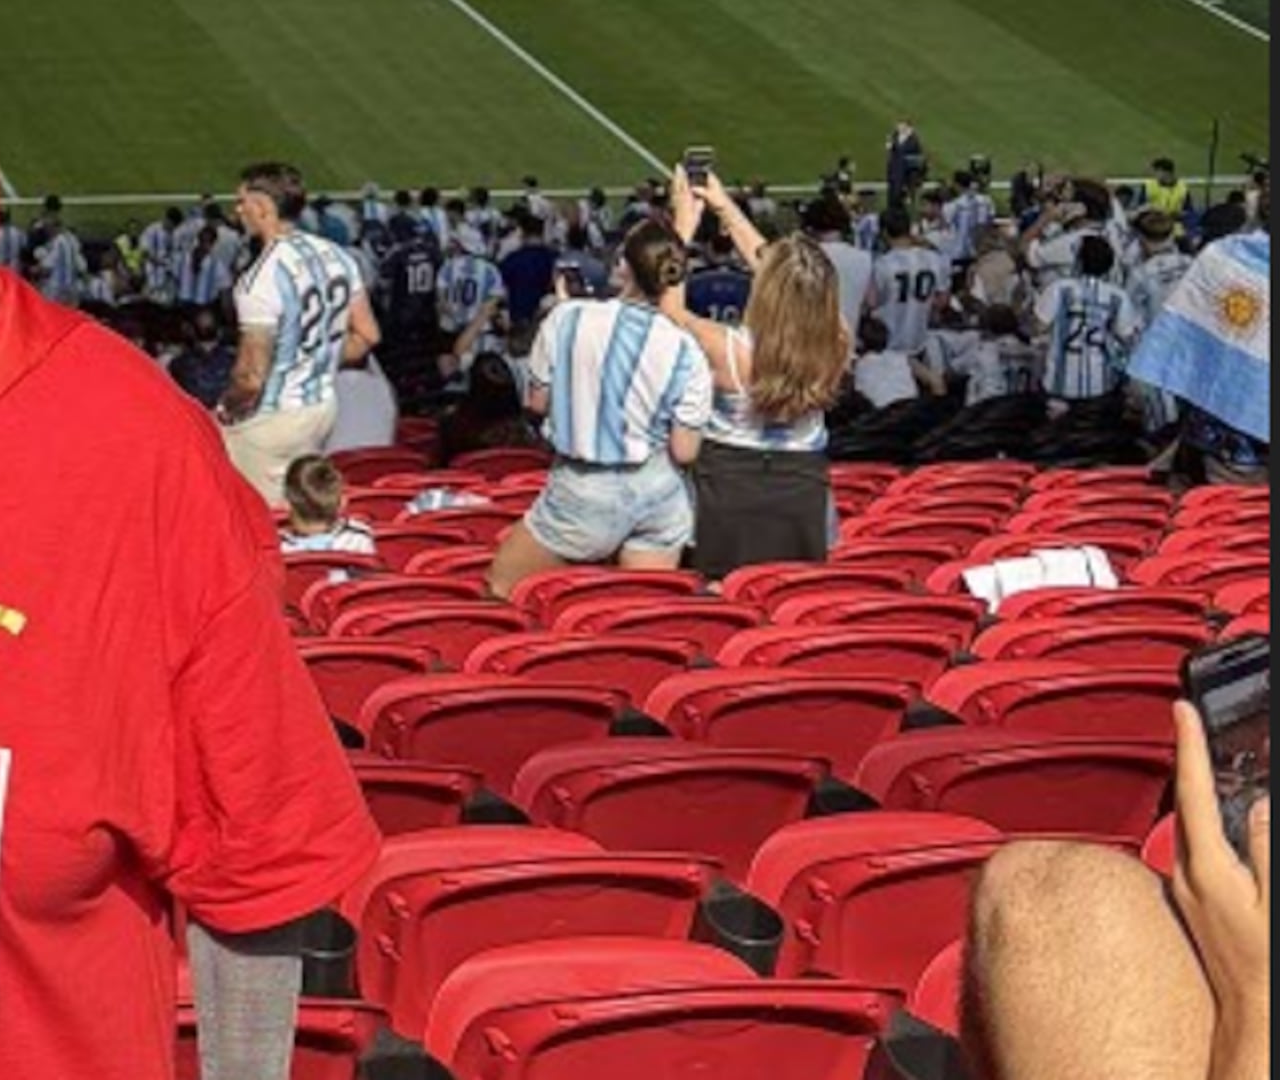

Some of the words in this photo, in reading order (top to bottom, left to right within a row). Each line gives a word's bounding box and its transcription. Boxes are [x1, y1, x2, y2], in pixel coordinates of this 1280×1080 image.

[406, 261, 434, 295] 10
[895, 269, 936, 303] 10
[300, 275, 351, 356] 22
